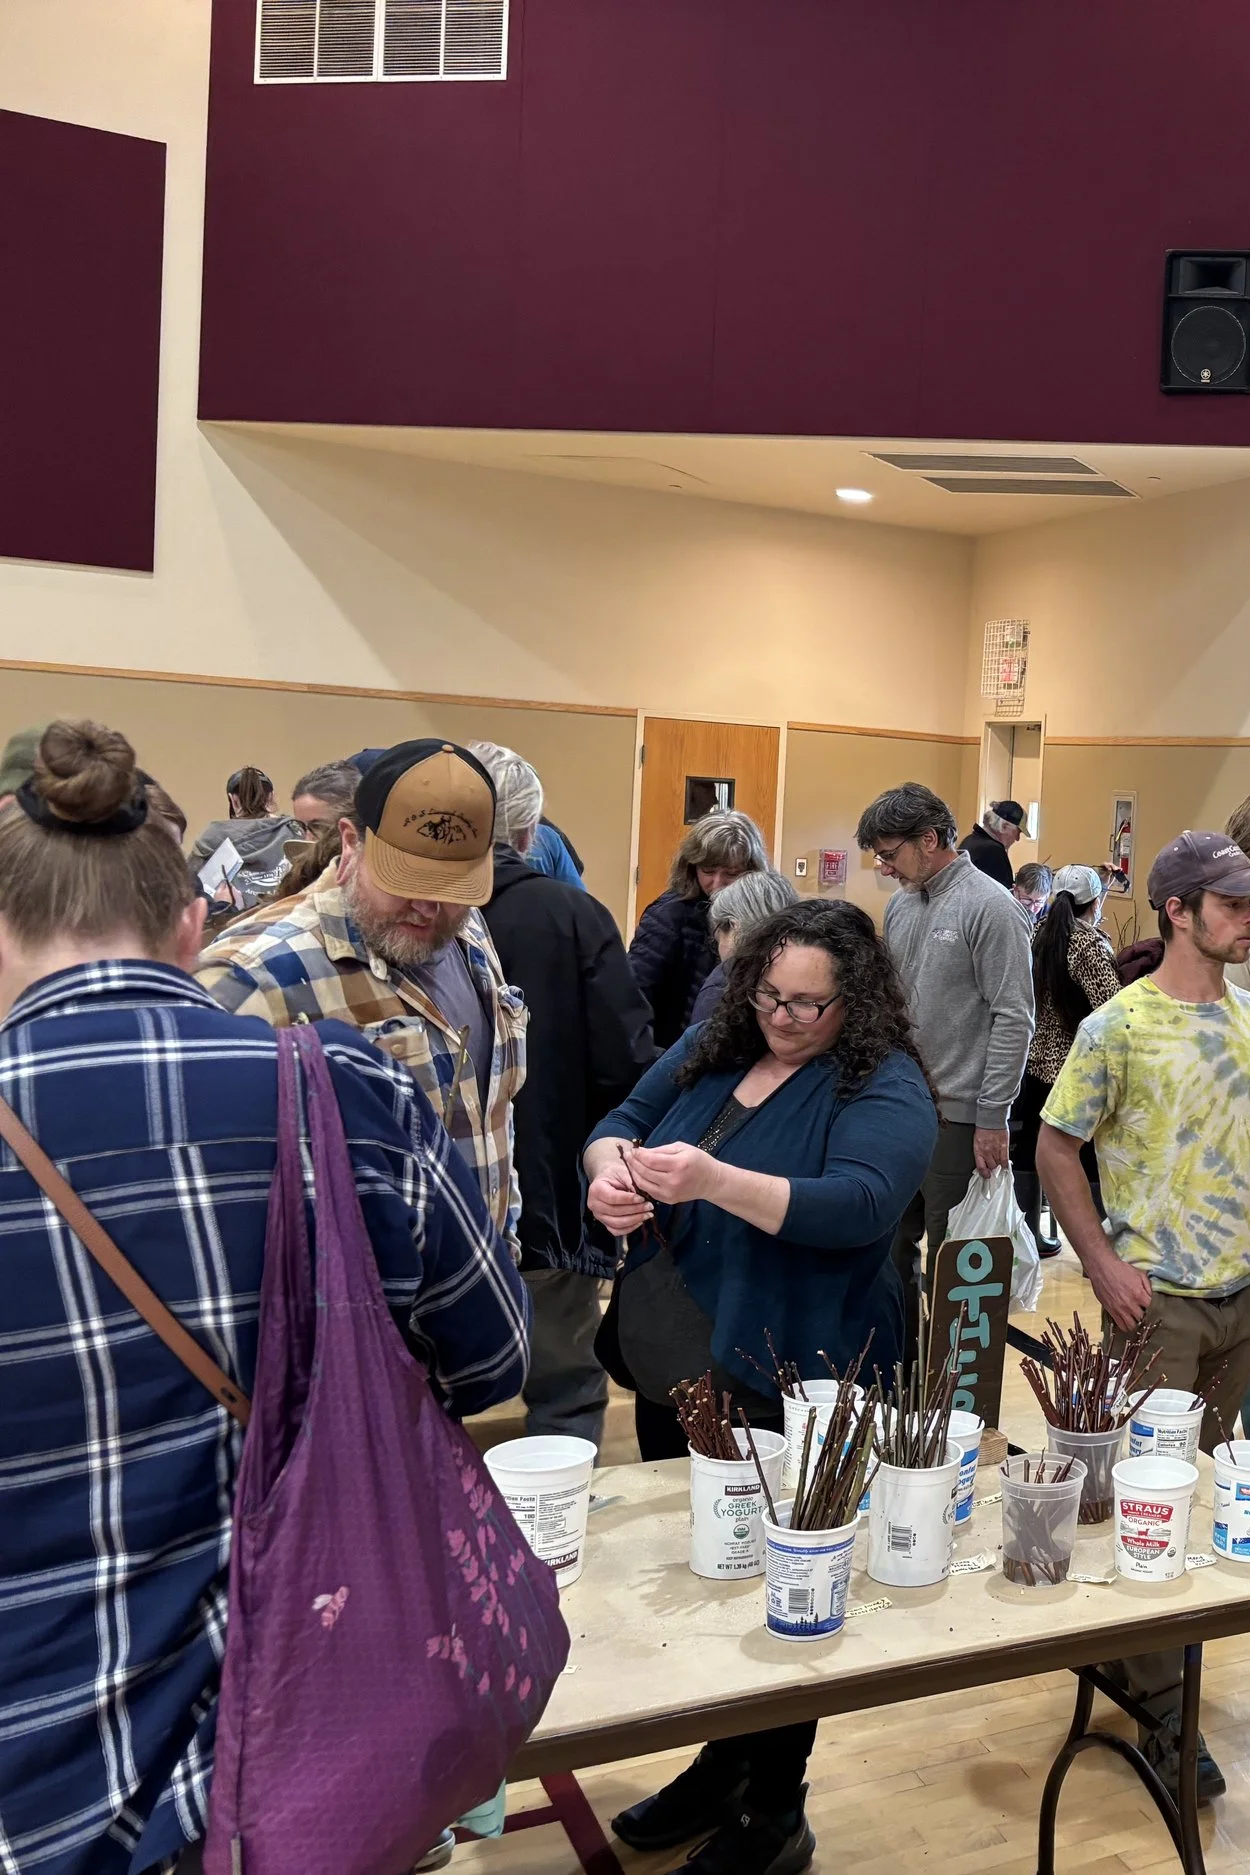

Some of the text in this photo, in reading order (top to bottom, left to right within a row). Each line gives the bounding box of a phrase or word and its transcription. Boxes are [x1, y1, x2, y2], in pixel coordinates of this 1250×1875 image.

[728, 1501, 757, 1509] GREEK
[1122, 1502, 1170, 1516] STRAUS
[721, 1505, 763, 1517] YOGURT
[1128, 1516, 1160, 1527] ORGANIC
[1127, 1537, 1144, 1547] Whole
[1126, 1545, 1160, 1555] EUROPEAN
[545, 1551, 578, 1566] IRKLAND
[1133, 1552, 1151, 1560] STYLE
[1135, 1561, 1148, 1569] Plain
